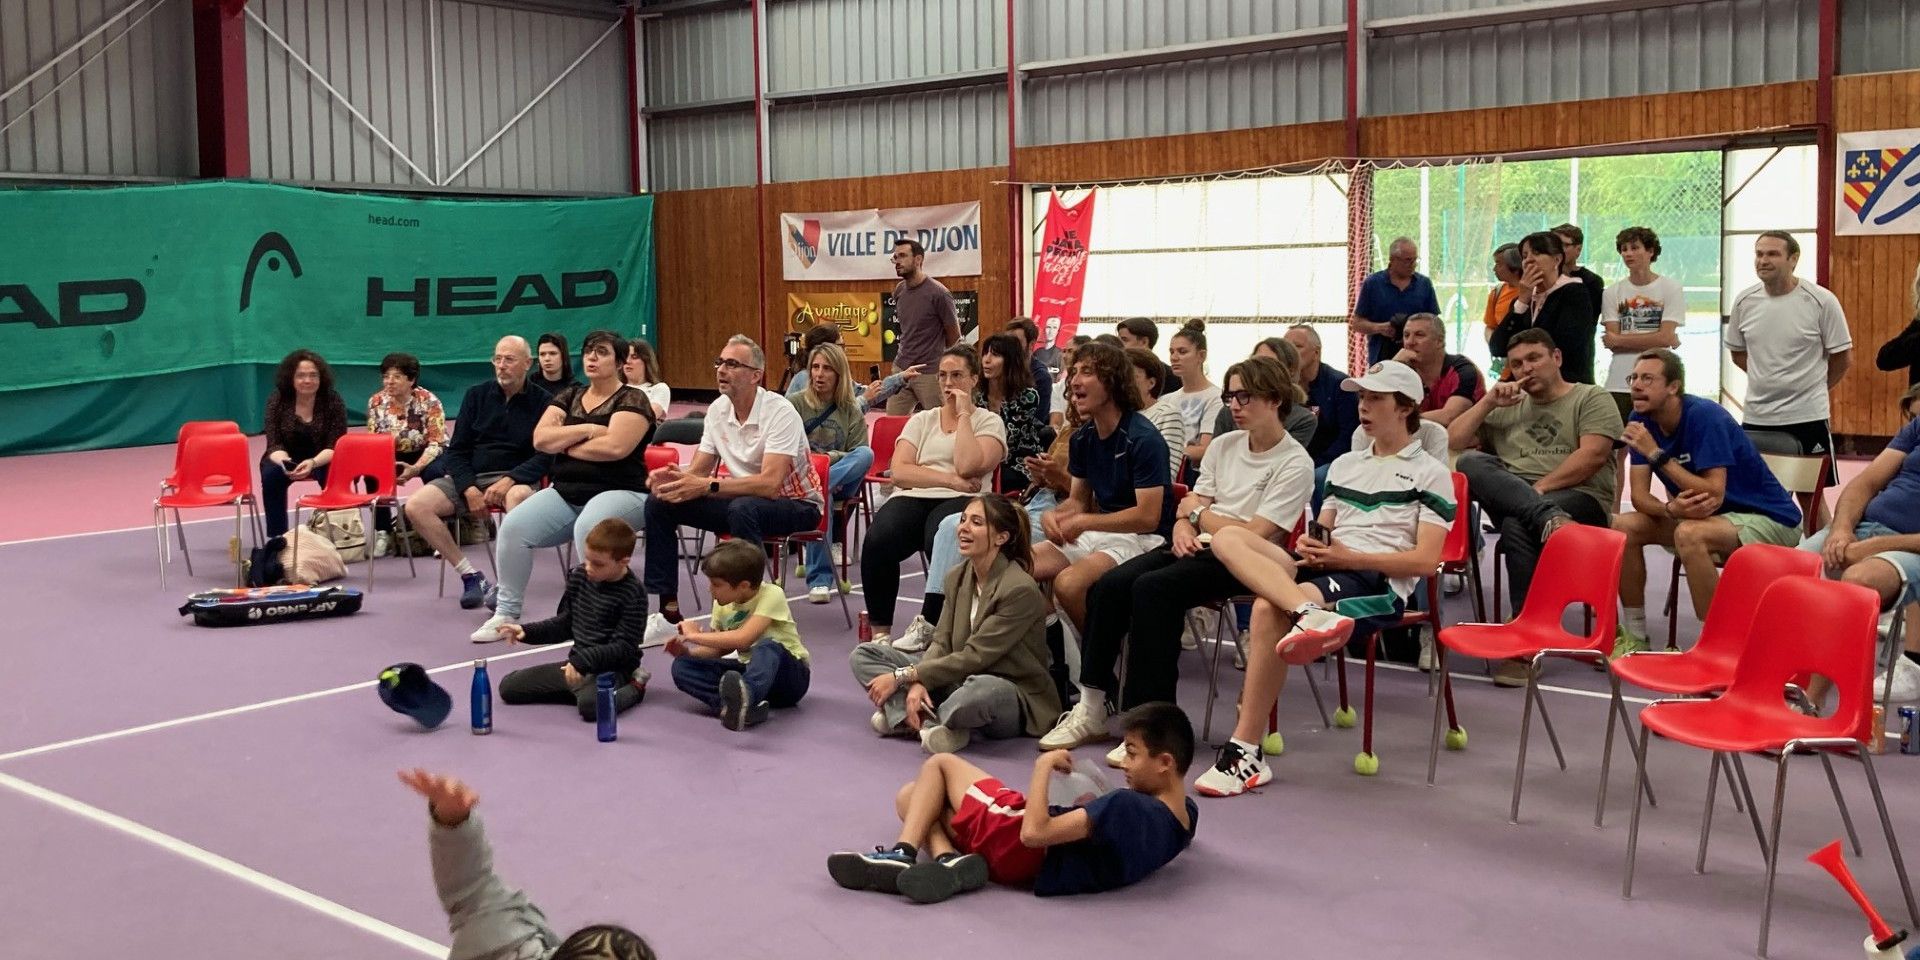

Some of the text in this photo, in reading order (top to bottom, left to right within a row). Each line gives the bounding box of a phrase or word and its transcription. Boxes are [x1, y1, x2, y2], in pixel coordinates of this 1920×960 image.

[368, 213, 420, 228] head.com
[827, 231, 876, 256] VILLE
[917, 224, 978, 253] DIJON
[366, 269, 619, 317] HEAD
[796, 301, 868, 331] Avantage
